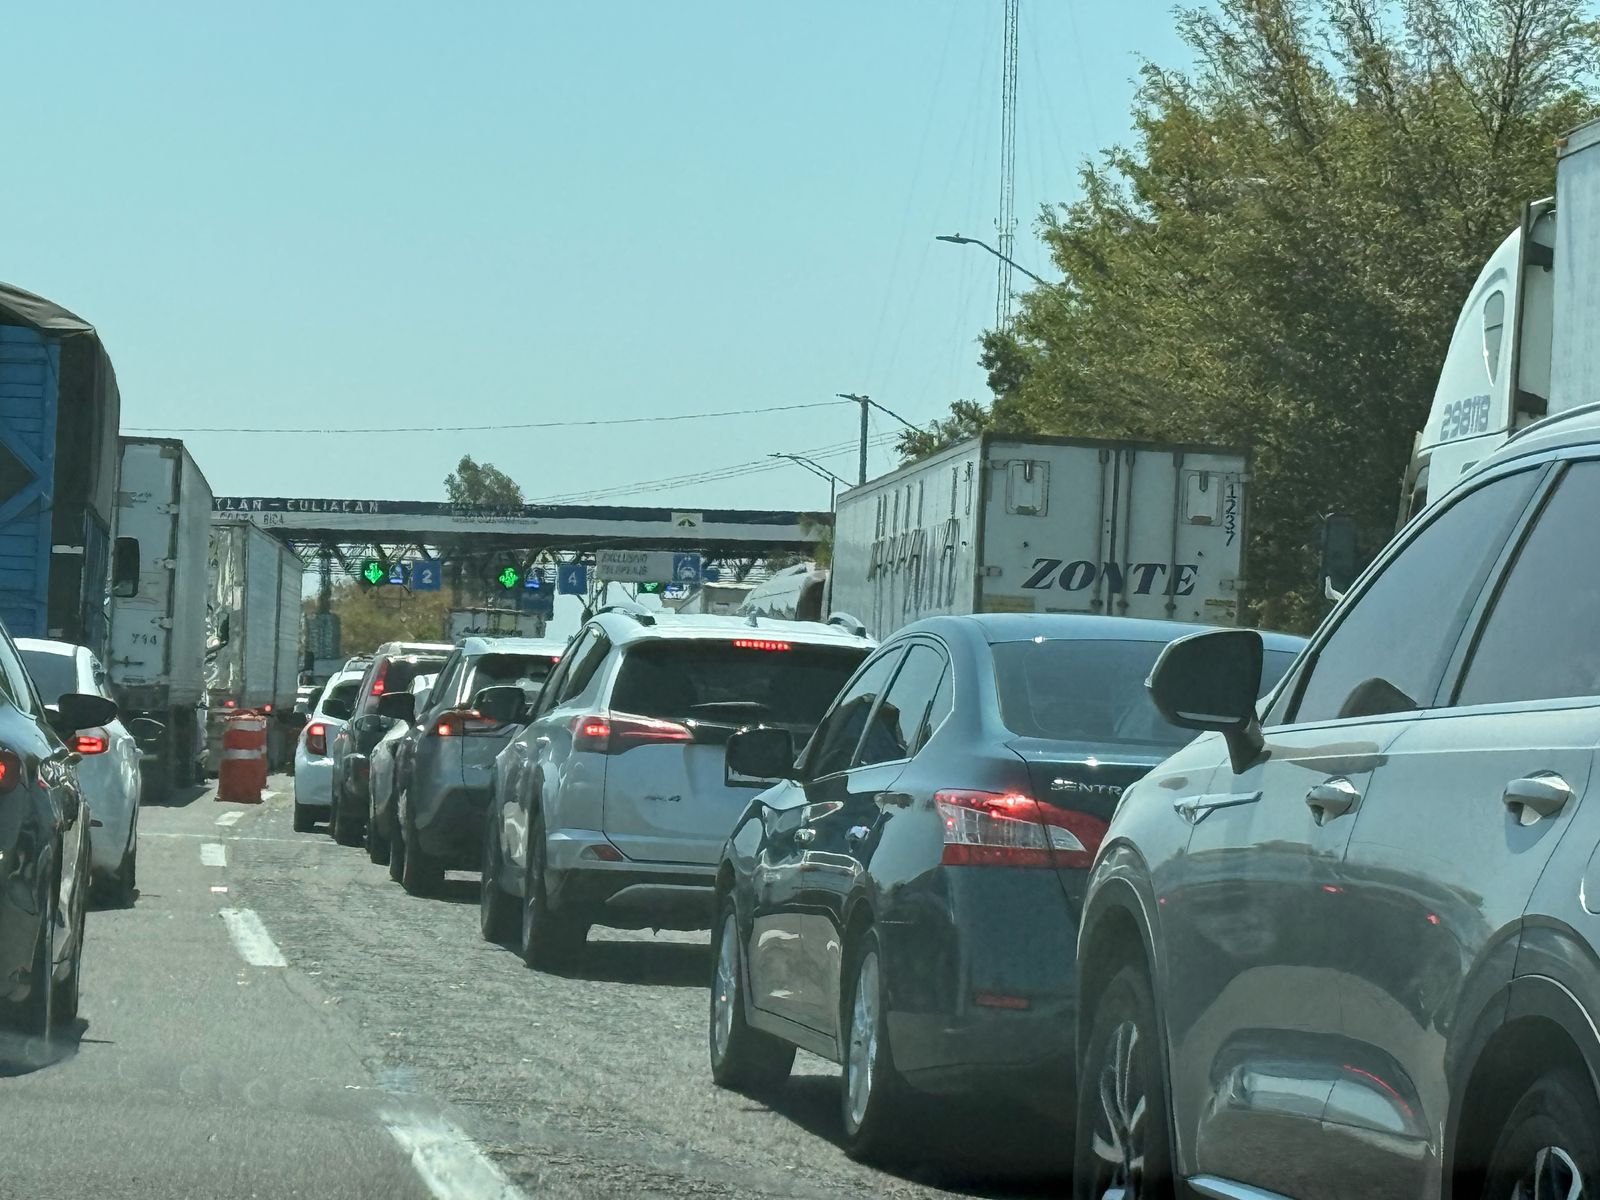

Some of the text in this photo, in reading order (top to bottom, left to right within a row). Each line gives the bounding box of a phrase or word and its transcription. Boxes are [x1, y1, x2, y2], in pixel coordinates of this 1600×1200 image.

[1225, 483, 1238, 547] 1237
[422, 569, 432, 584] 2
[568, 571, 577, 586] 4
[1020, 558, 1199, 597] ZONTE
[1050, 779, 1123, 797] SENTR
